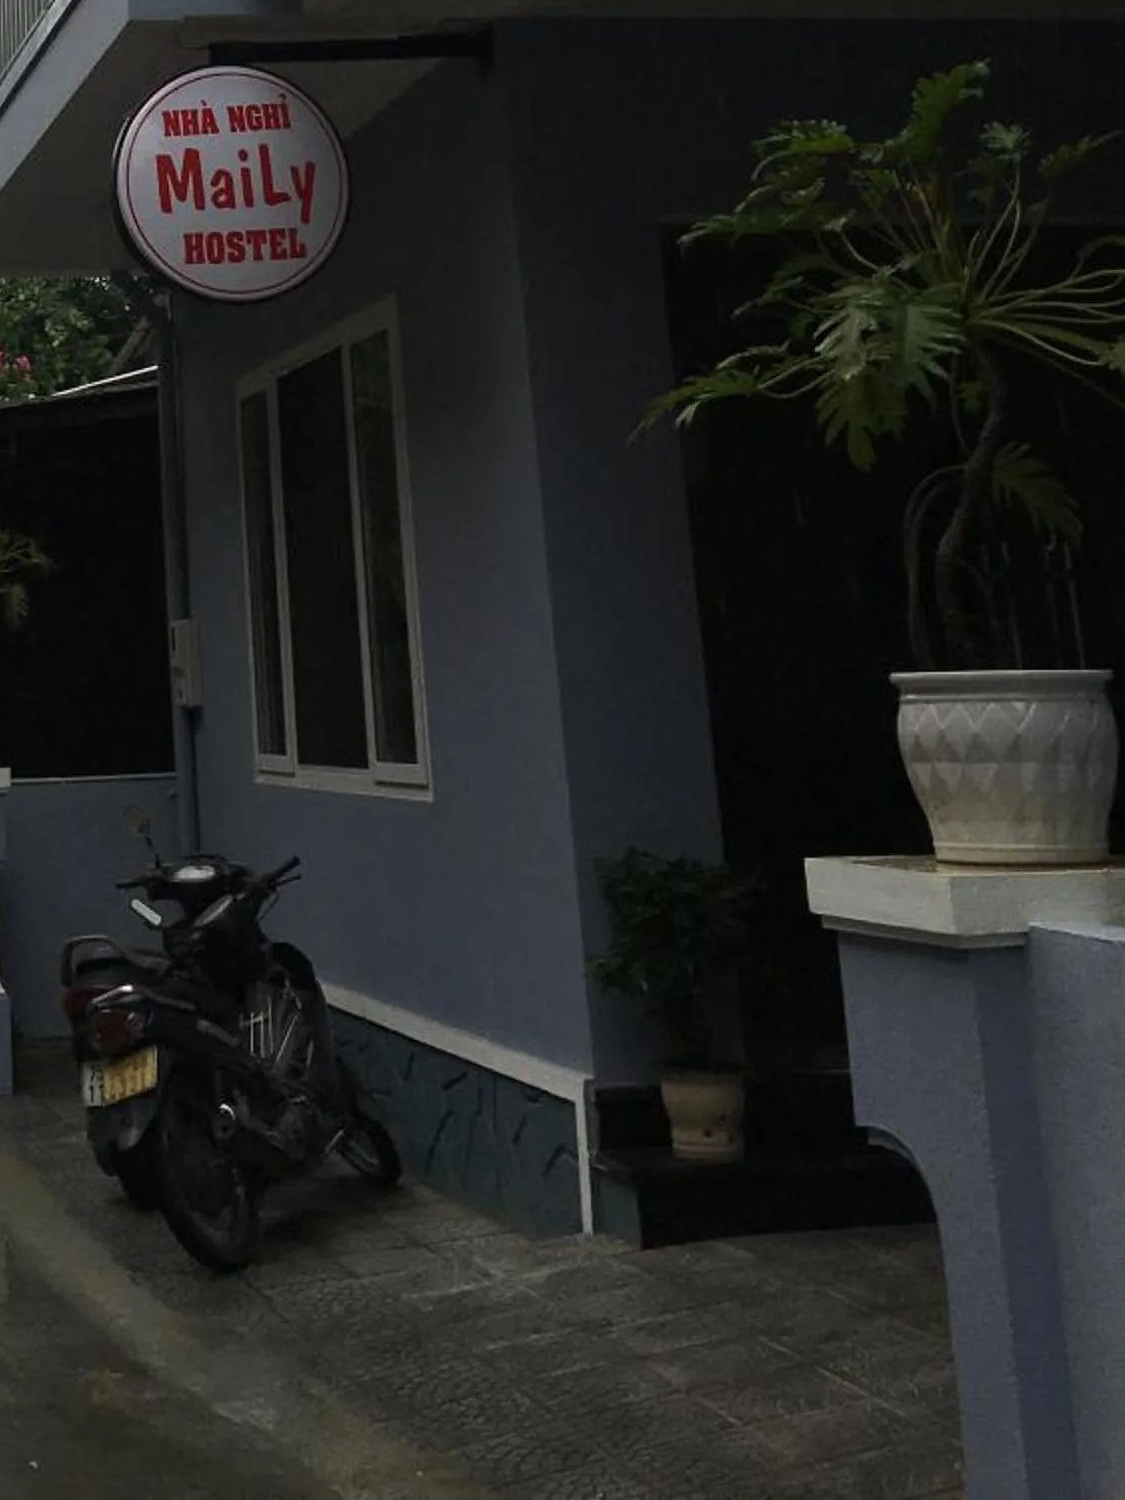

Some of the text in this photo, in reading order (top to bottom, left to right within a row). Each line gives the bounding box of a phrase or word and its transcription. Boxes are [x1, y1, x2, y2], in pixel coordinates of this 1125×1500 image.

[162, 101, 219, 137] NHÀ
[156, 144, 316, 225] MaiLy
[183, 228, 307, 265] HOSTEL
